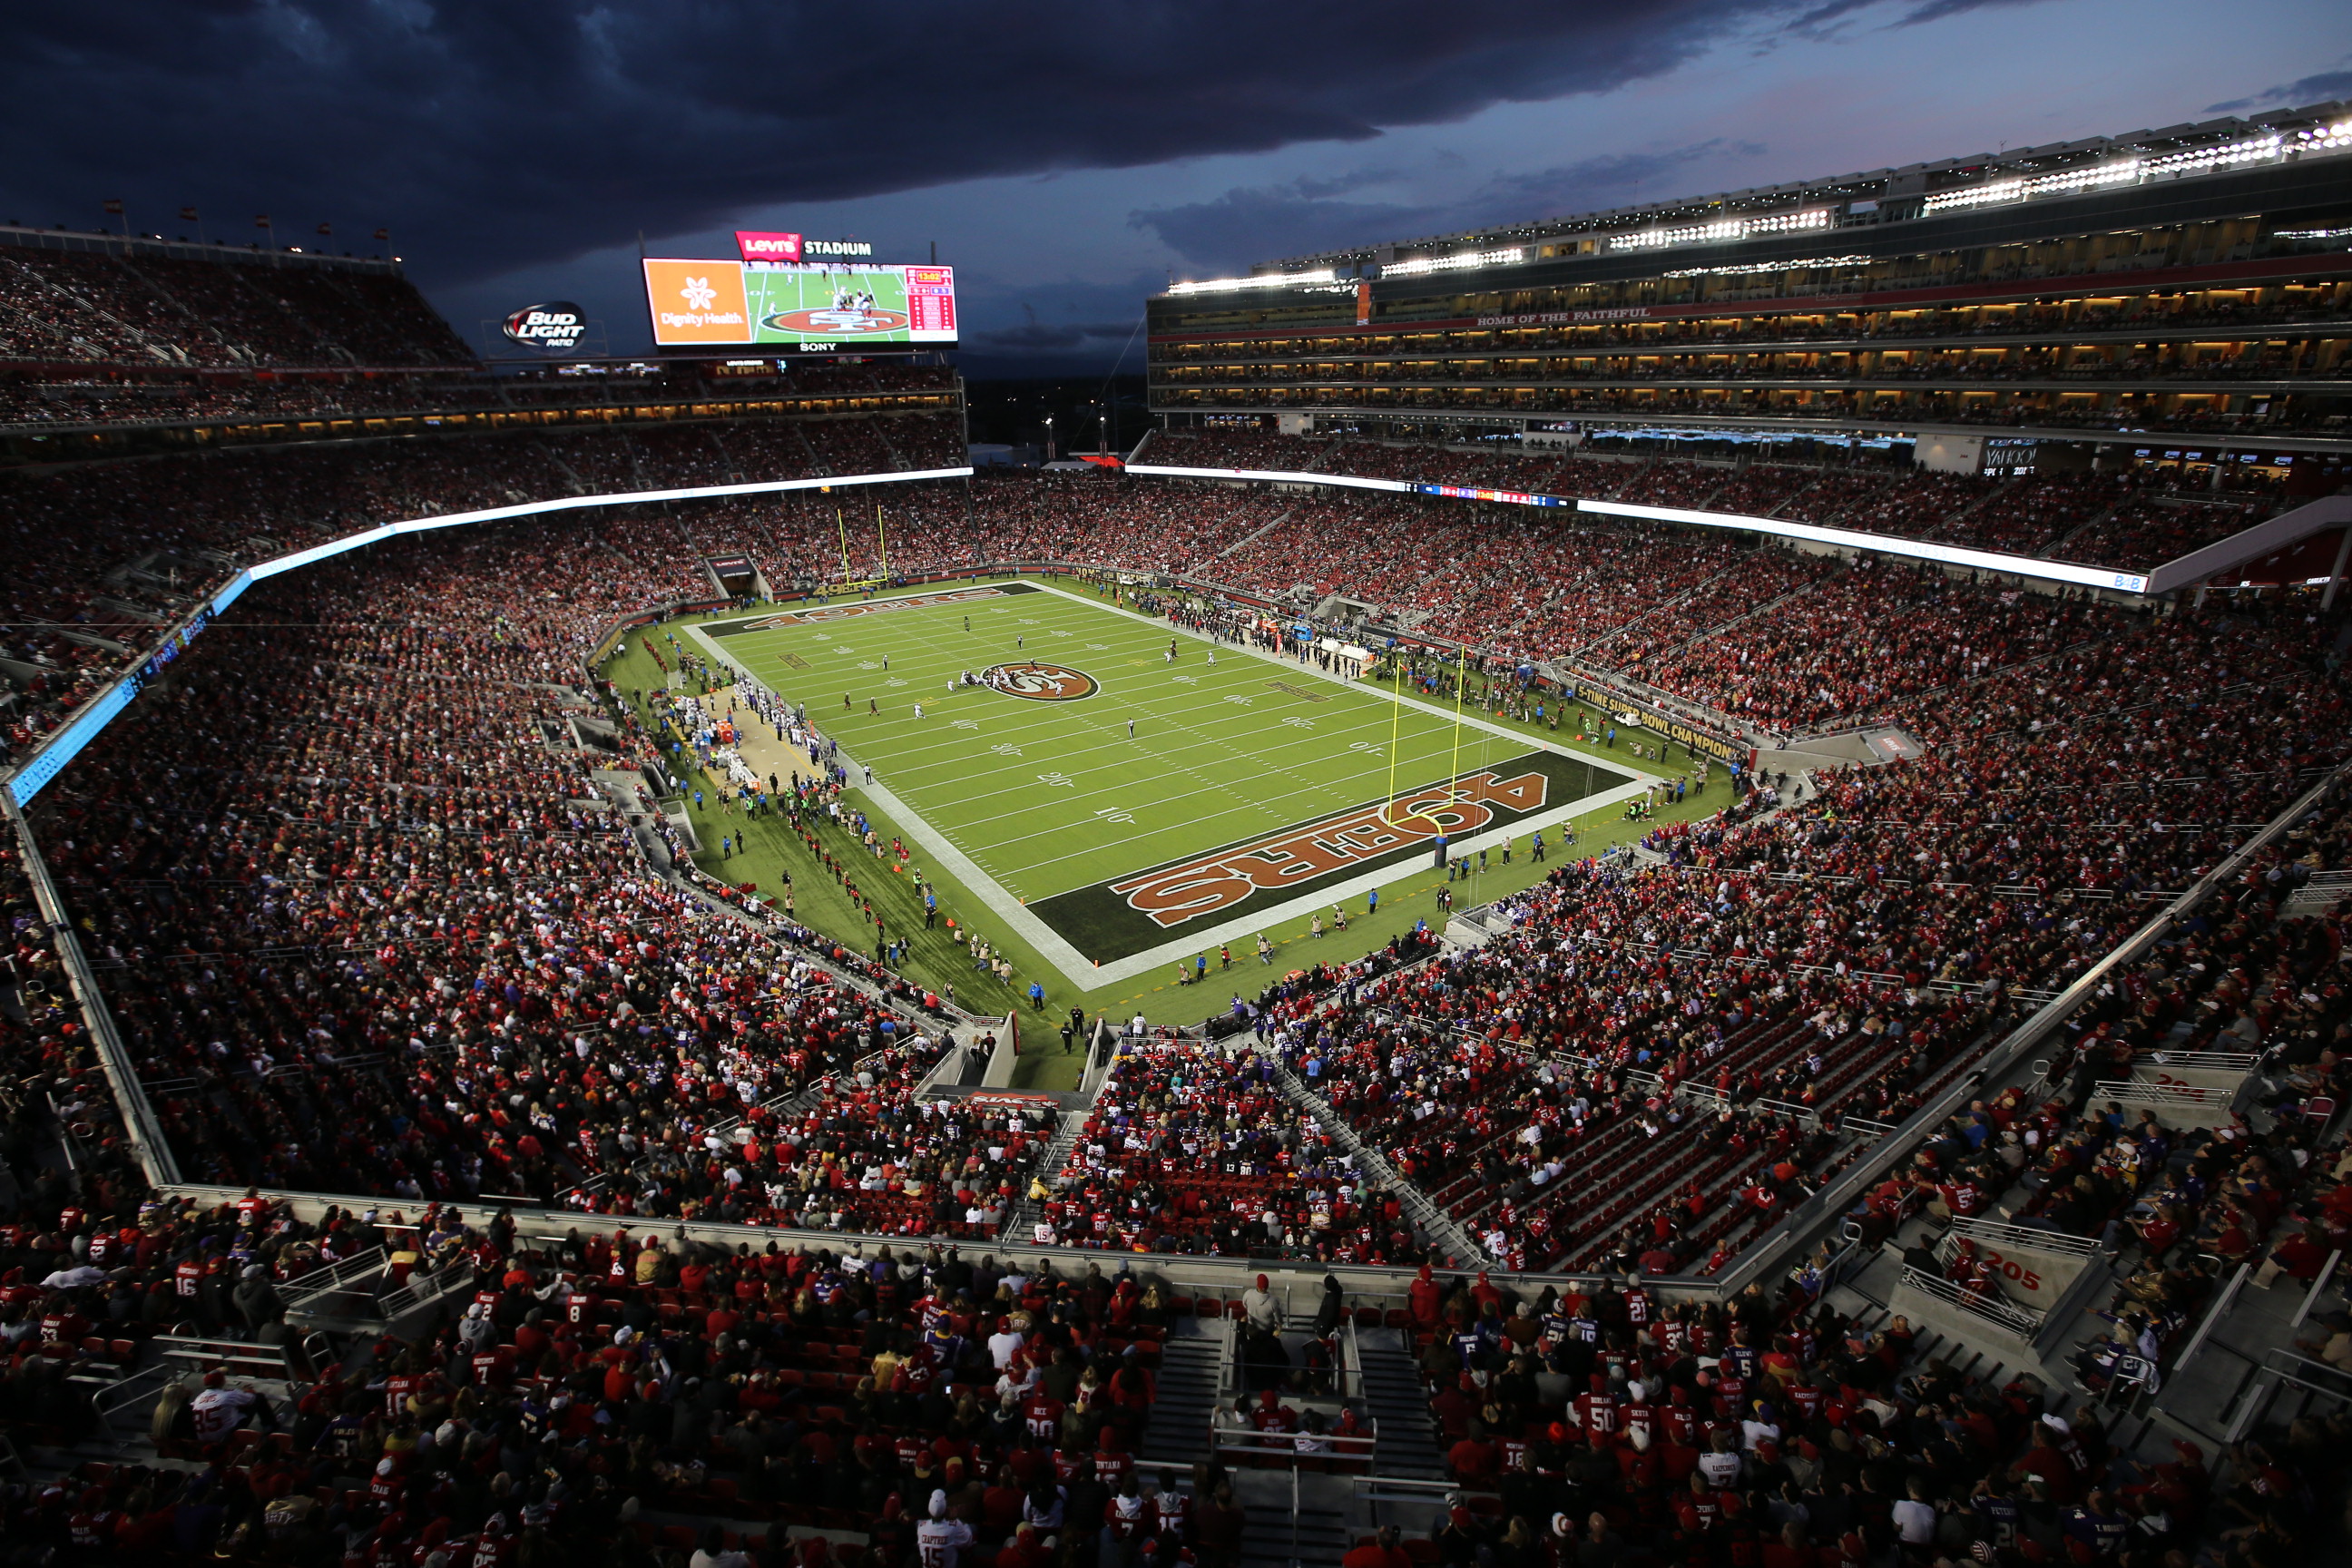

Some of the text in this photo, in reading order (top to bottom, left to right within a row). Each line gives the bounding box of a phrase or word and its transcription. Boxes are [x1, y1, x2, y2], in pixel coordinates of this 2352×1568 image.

[804, 240, 872, 256] STADIUM
[516, 311, 584, 338] BUD LIGHT
[662, 313, 742, 328] Dignity Health
[1477, 308, 1651, 326] HOME OF THE FAITHFUL
[545, 338, 574, 348] PATIO
[799, 342, 837, 351] SONY
[1986, 448, 2037, 466] YAHOO!
[1476, 491, 1494, 500] 13:02
[1757, 518, 1808, 537] BUSINESS
[1852, 534, 1877, 548] FOR
[1883, 538, 1948, 558] BUSINESS
[2114, 575, 2140, 590] B4B
[1281, 716, 1316, 730] 20
[1577, 685, 1608, 708] 5-TIME
[1641, 711, 1671, 735] BOWL
[1671, 724, 1733, 760] CHAMPION
[990, 742, 1017, 757] 30
[1348, 741, 1385, 757] 10
[1036, 771, 1068, 787] 20
[1093, 806, 1129, 824] 10
[1108, 770, 1550, 929] 49ERS
[2155, 1073, 2206, 1102] 204
[1226, 1163, 1235, 1171] 13
[1240, 1165, 1252, 1175] 80
[1094, 1220, 1109, 1231] 80
[1297, 1213, 1309, 1223] 87
[1038, 1230, 1047, 1240] 15
[1125, 1238, 1132, 1247] 7
[1362, 1232, 1371, 1241] 94
[1984, 1250, 2041, 1291] 205
[175, 1278, 198, 1297] 16
[570, 1306, 581, 1323] 8
[1629, 1302, 1648, 1322] 21
[1740, 1358, 1752, 1377] 5
[477, 1367, 488, 1386] 7
[386, 1392, 408, 1416] 16
[1034, 1407, 1046, 1416] RICE
[1805, 1402, 1815, 1418] 7
[191, 1406, 222, 1433] 85
[1591, 1407, 1615, 1433] 50
[1631, 1409, 1650, 1417] SKUTA
[1025, 1417, 1054, 1438] 80
[2069, 1454, 2088, 1472] 16
[1121, 1522, 1133, 1538] 7
[1699, 1515, 1711, 1531] 7
[924, 1546, 946, 1568] 15
